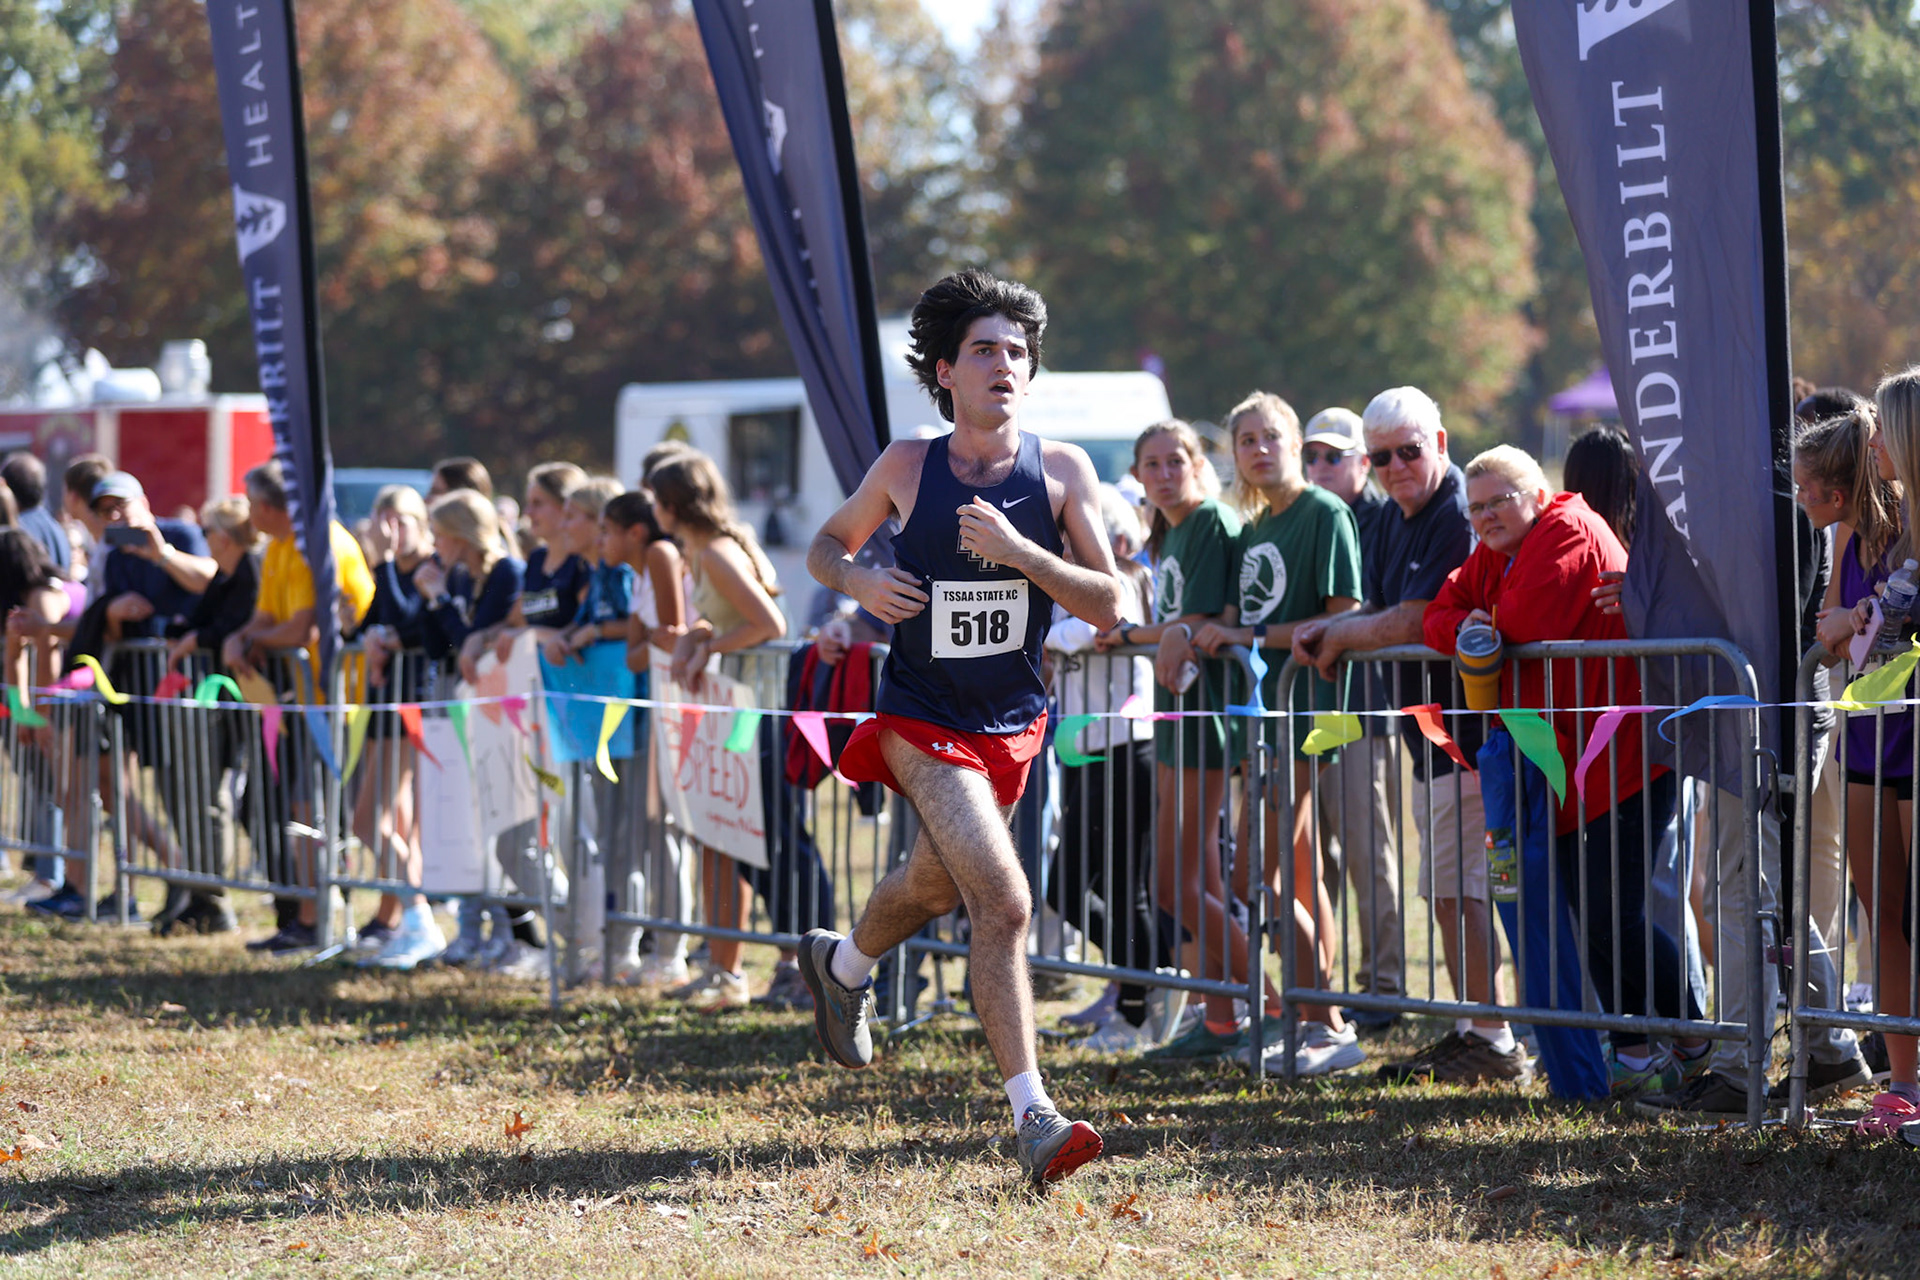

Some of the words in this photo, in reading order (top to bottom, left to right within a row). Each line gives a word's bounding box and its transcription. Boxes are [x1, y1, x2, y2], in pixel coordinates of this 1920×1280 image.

[235, 3, 274, 168] HEALT
[1611, 81, 1699, 567] ANDERBILT
[943, 590, 974, 602] TSSAA
[976, 590, 1004, 601] STATE
[1006, 589, 1018, 600] XC
[951, 609, 1010, 646] 518
